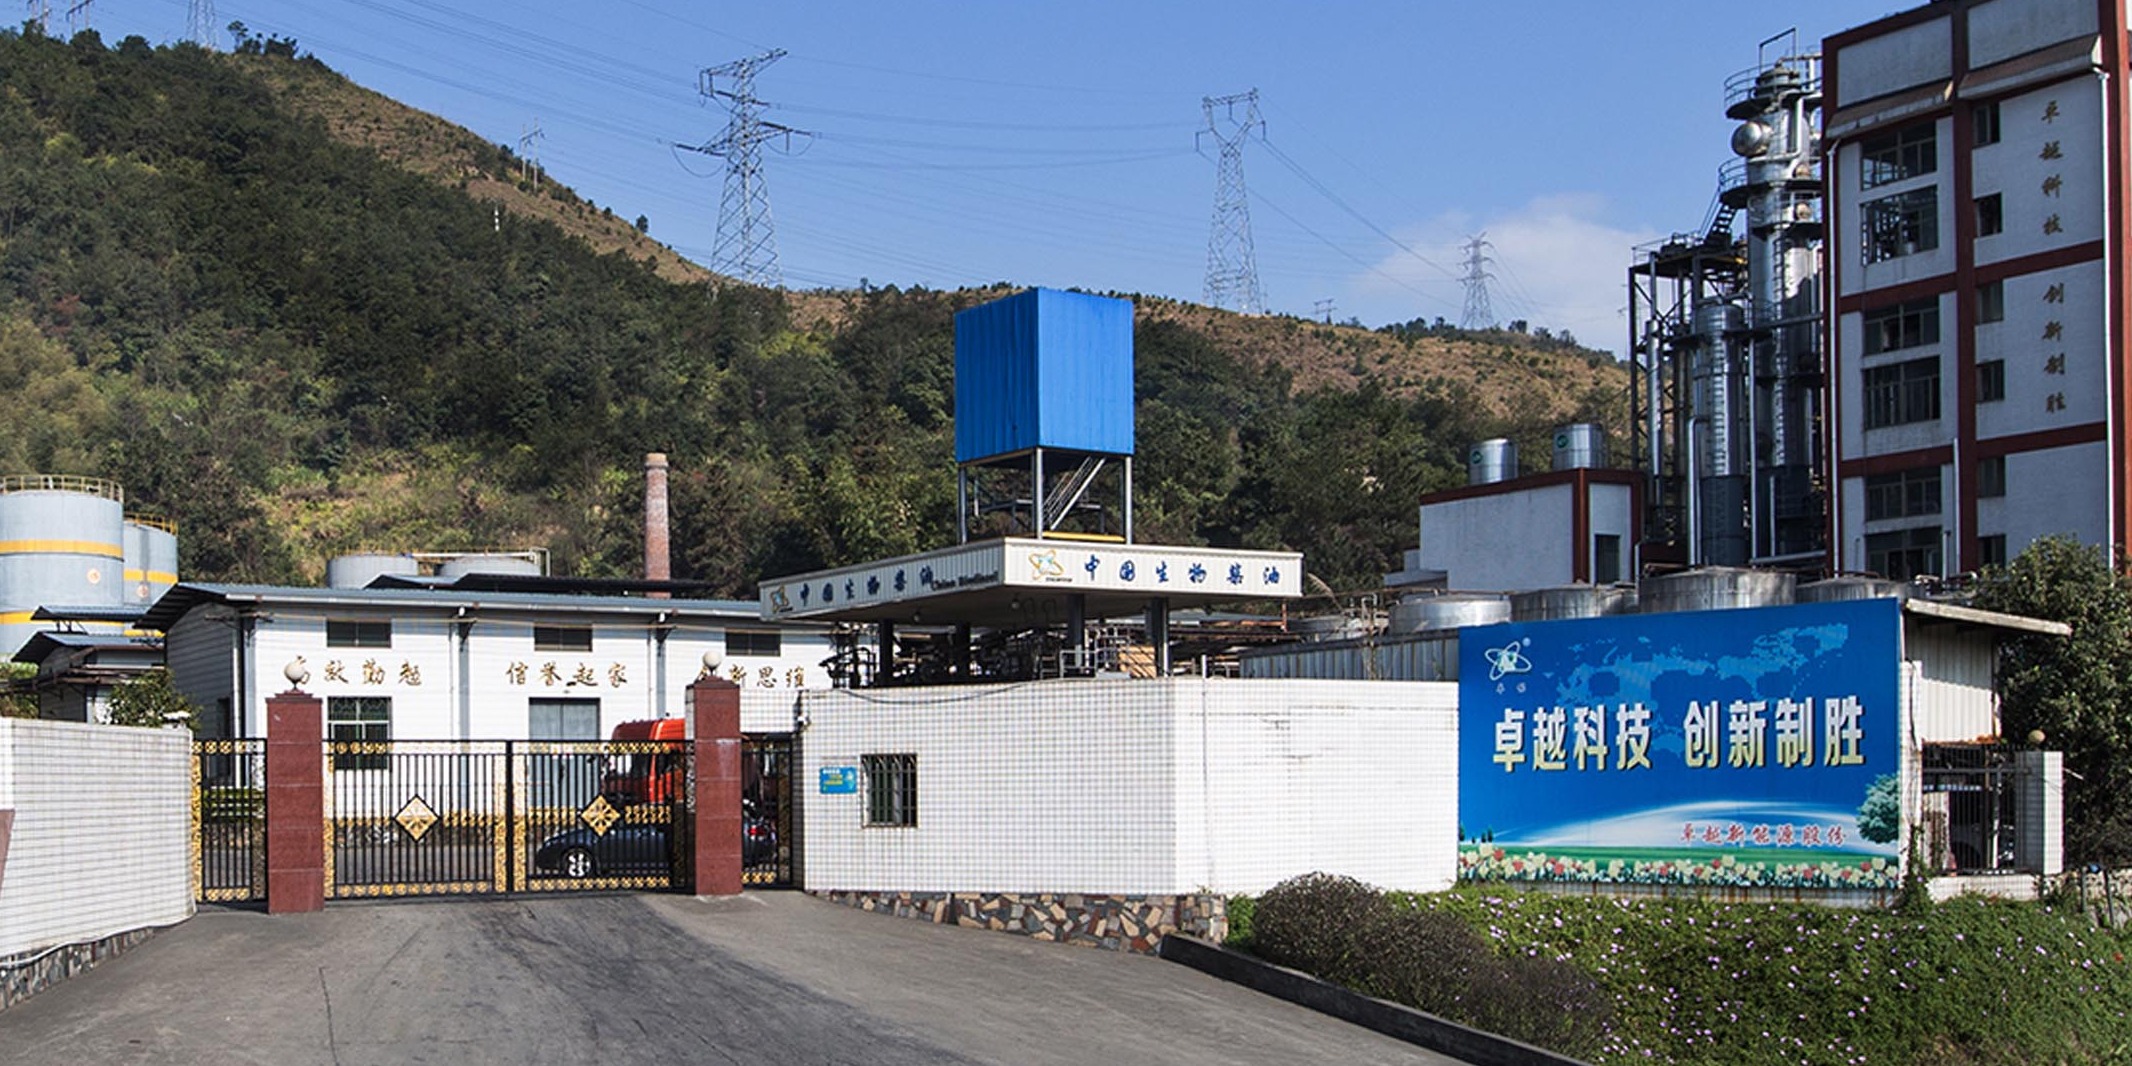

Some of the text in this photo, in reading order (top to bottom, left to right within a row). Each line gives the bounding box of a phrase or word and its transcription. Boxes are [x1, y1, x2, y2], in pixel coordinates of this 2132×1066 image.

[2038, 100, 2066, 413] 卓越科技 创新制胜
[801, 565, 933, 606] 中国生物柴油
[1084, 554, 1280, 586] 中国生物柴油
[505, 661, 627, 688] 信誉起家
[1492, 695, 1867, 774] 卓越科技 创新制胜
[1680, 821, 1847, 847] 卓越新能源股份
